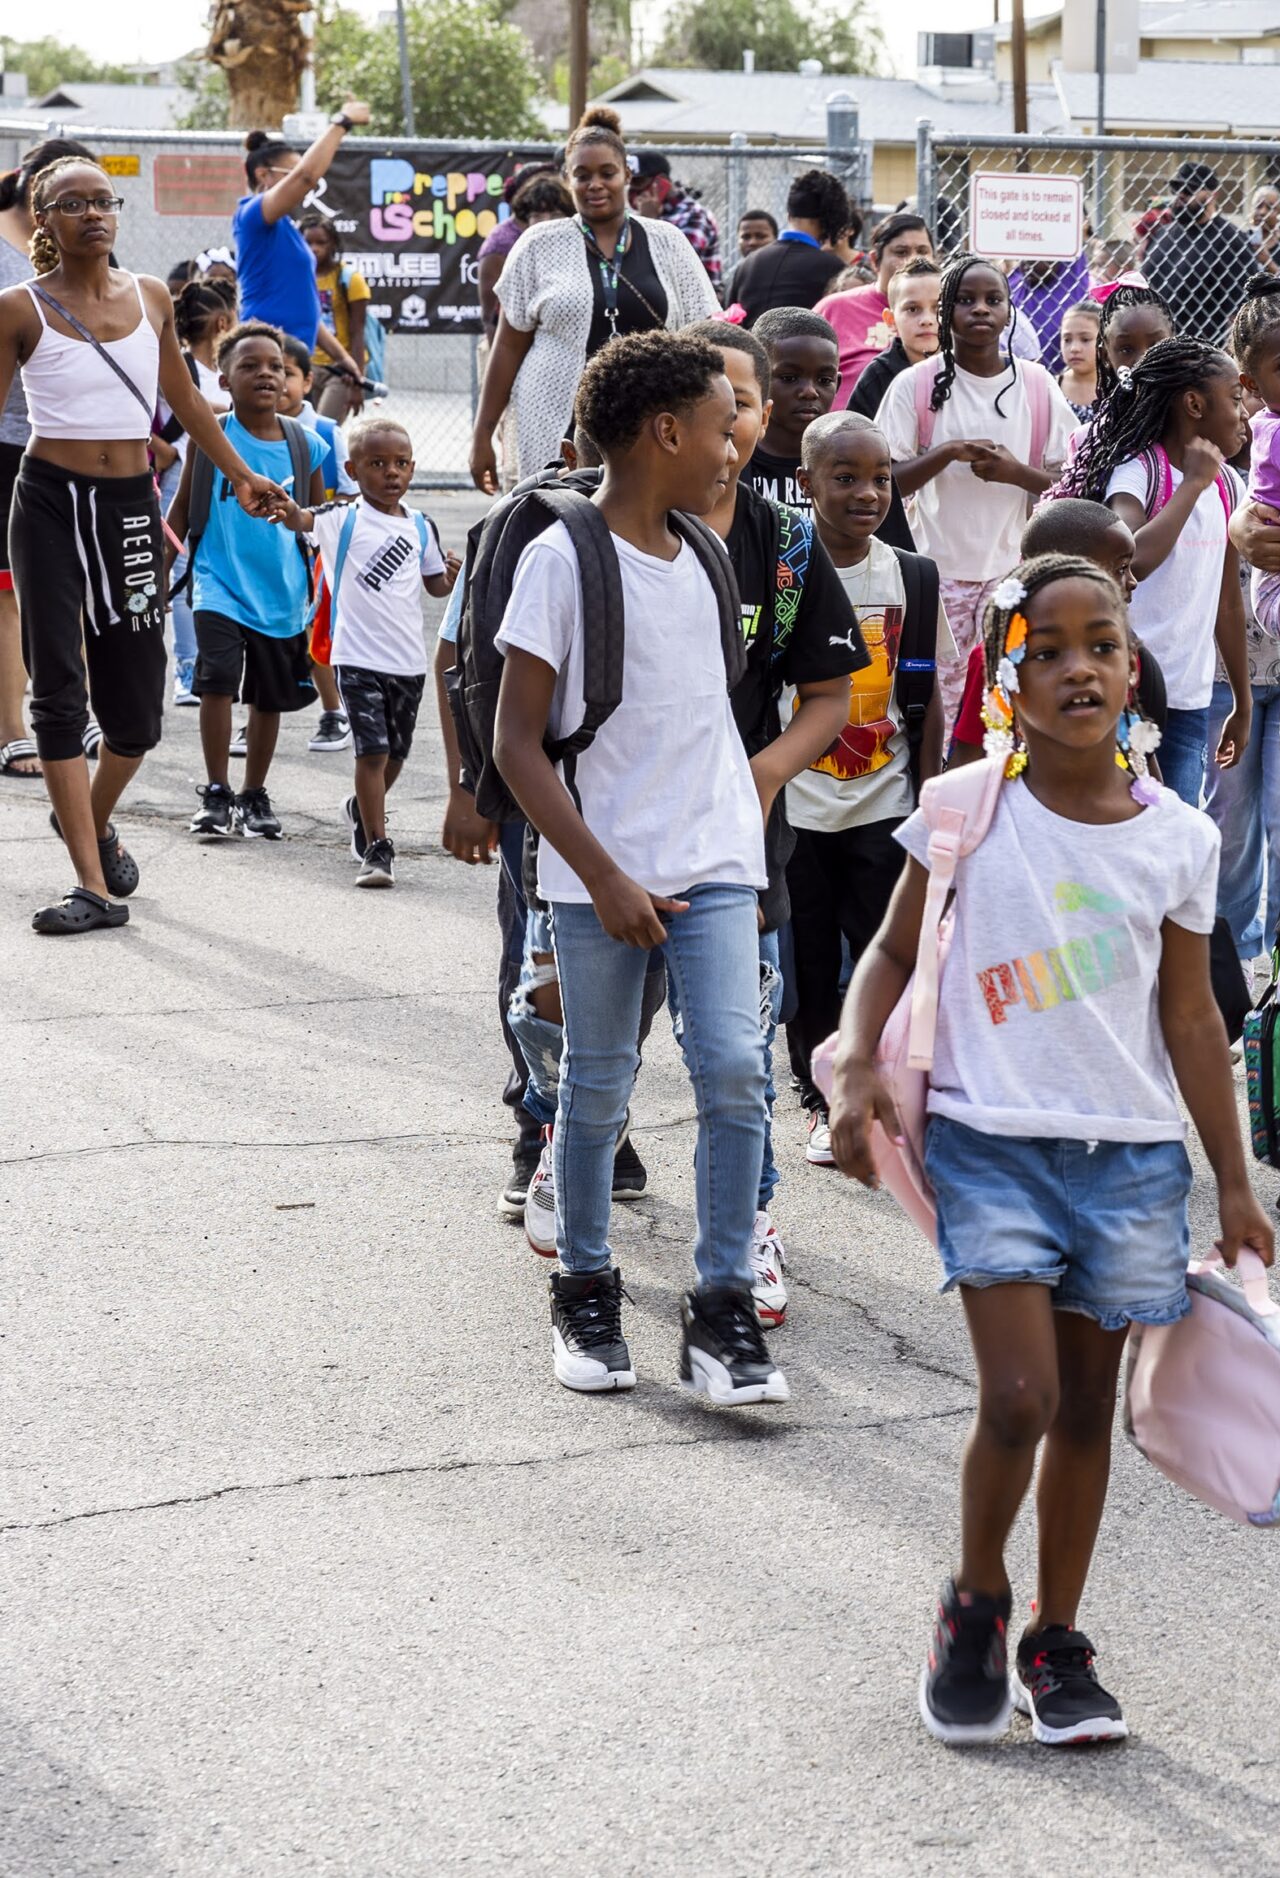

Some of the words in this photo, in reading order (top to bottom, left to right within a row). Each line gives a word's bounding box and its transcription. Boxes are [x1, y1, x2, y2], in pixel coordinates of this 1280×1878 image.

[370, 159, 504, 211] Preppe
[979, 188, 997, 199] This
[1000, 191, 1019, 203] gate
[1022, 190, 1029, 201] is
[1032, 191, 1041, 201] to
[1043, 192, 1073, 203] remain
[981, 209, 1010, 220] closed
[1012, 210, 1028, 221] and
[1031, 211, 1060, 222] locked
[1062, 213, 1071, 223] at
[1006, 230, 1016, 241] all
[1018, 230, 1045, 242] times.
[384, 252, 441, 278] LEE
[753, 476, 778, 502] I'M
[785, 476, 812, 504] RE
[123, 515, 155, 586] AERO
[363, 535, 414, 592] PUMA
